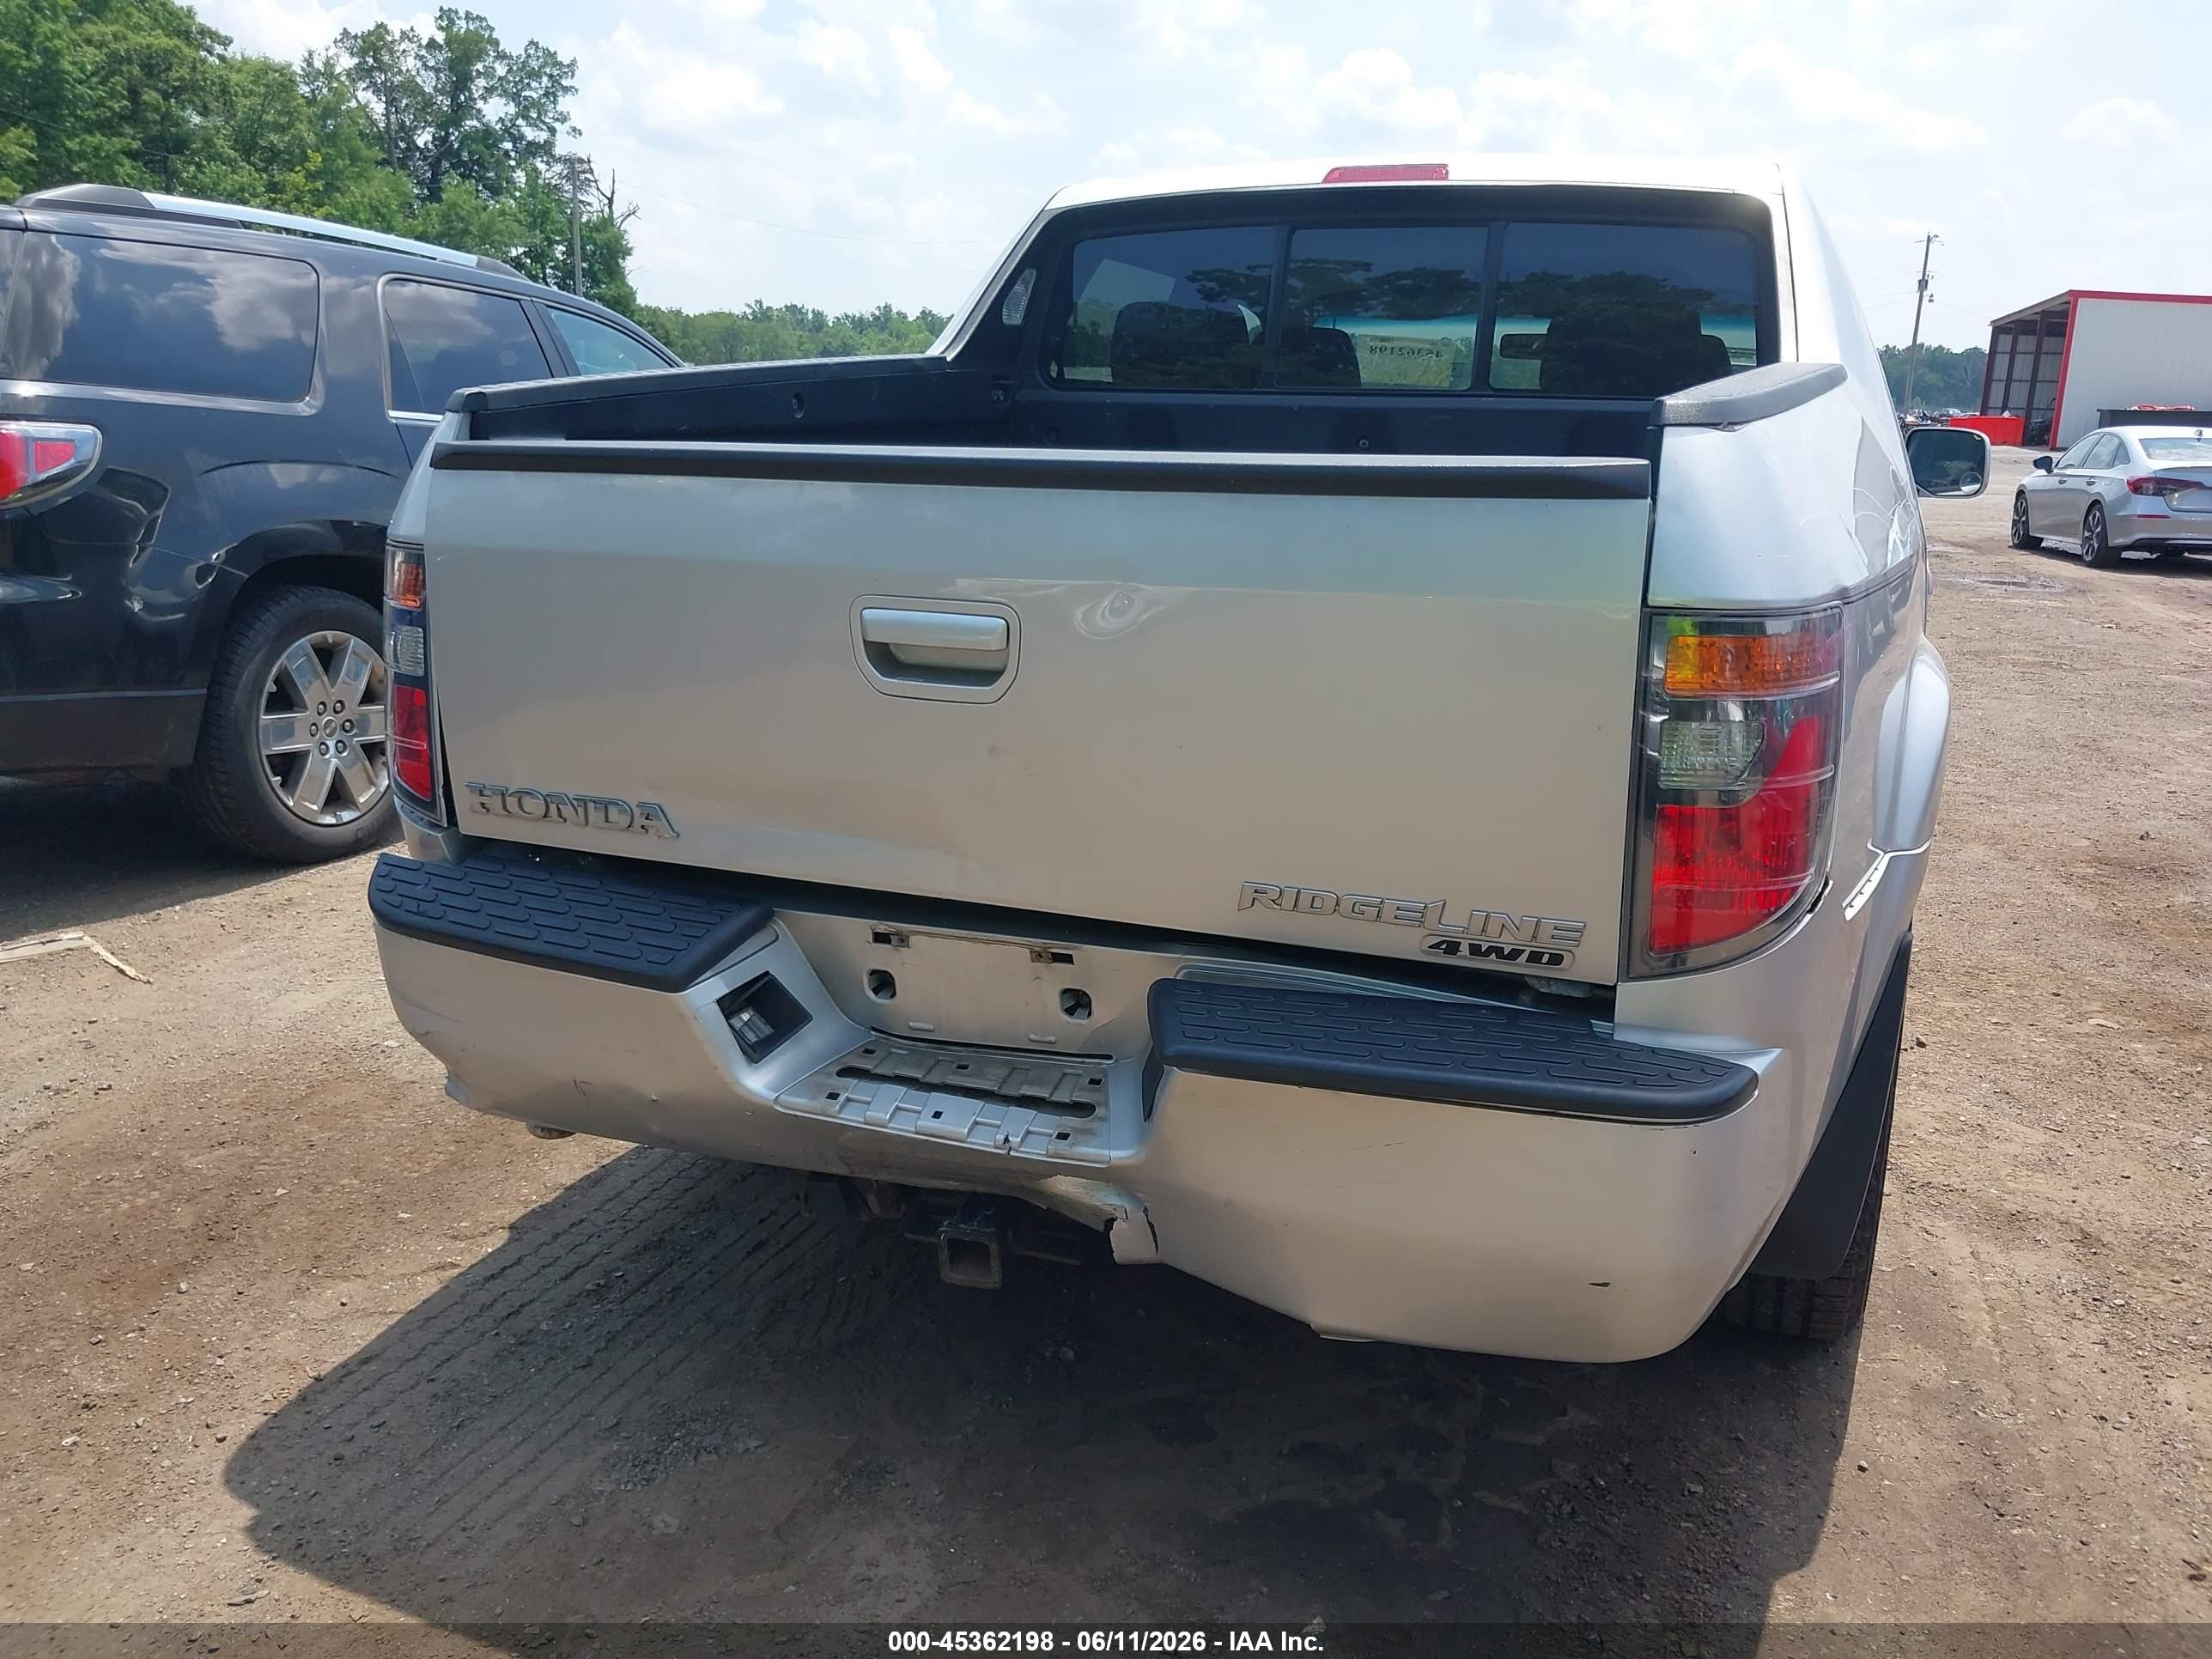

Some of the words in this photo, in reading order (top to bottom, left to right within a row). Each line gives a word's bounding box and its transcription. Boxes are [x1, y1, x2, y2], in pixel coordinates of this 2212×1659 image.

[465, 781, 680, 839] HONDA
[1237, 881, 1586, 947] RIDGELINE
[1427, 938, 1565, 968] 4WD
